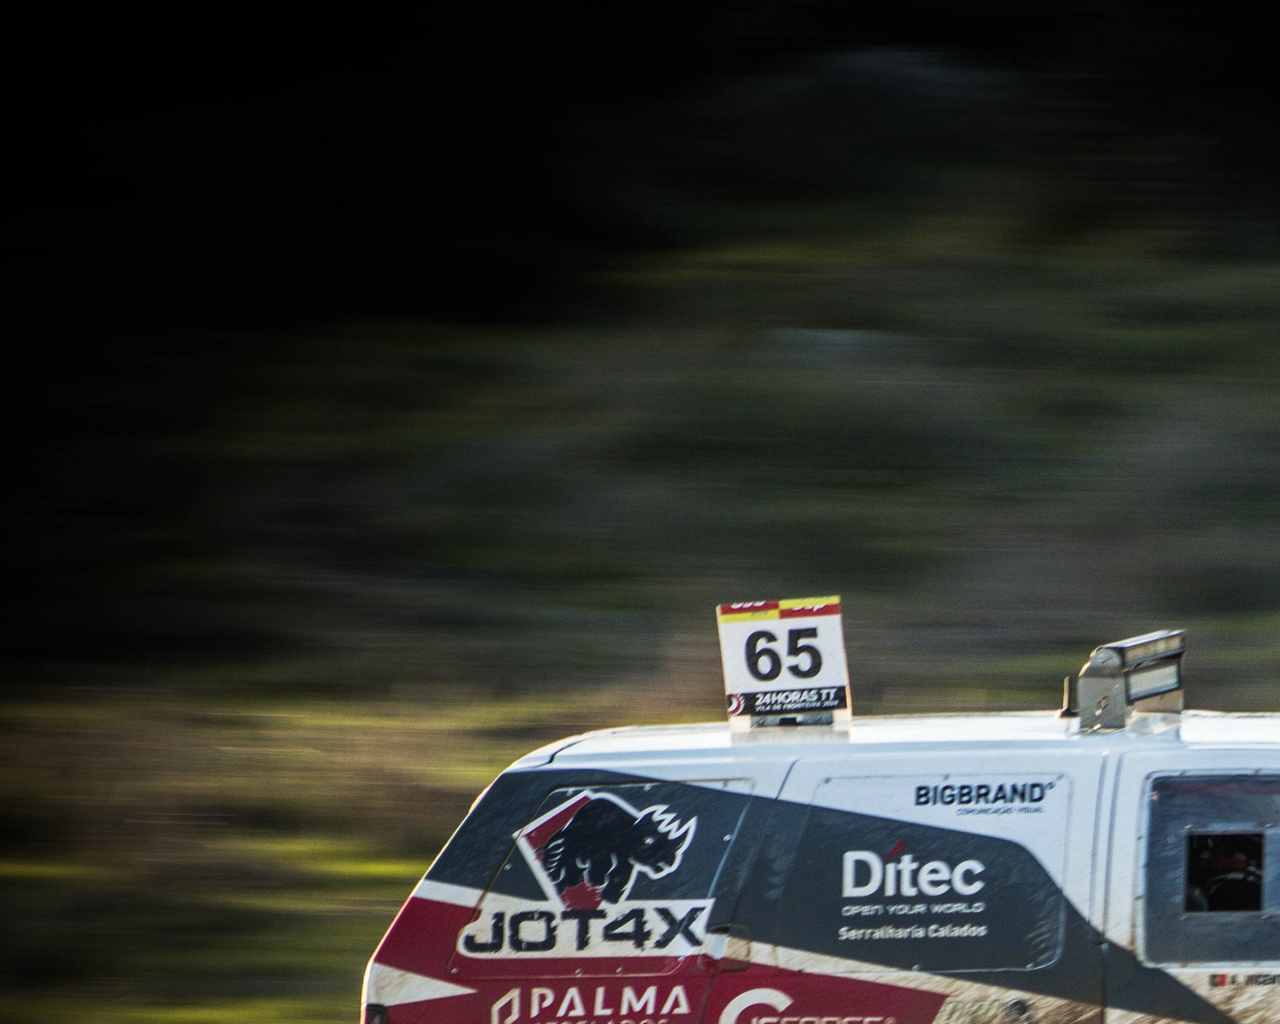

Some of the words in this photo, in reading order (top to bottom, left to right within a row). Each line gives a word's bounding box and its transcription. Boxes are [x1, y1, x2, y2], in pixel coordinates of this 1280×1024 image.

[745, 627, 823, 682] 65
[820, 688, 838, 701] TT
[914, 782, 1046, 806] BIGBRAND
[842, 840, 986, 898] Ditec
[841, 904, 884, 916] OPEN
[886, 903, 928, 915] YOUR
[929, 902, 986, 914] WORLD
[463, 906, 706, 953] JOT4X
[927, 922, 989, 938] Calados
[530, 985, 691, 1018] PALMA
